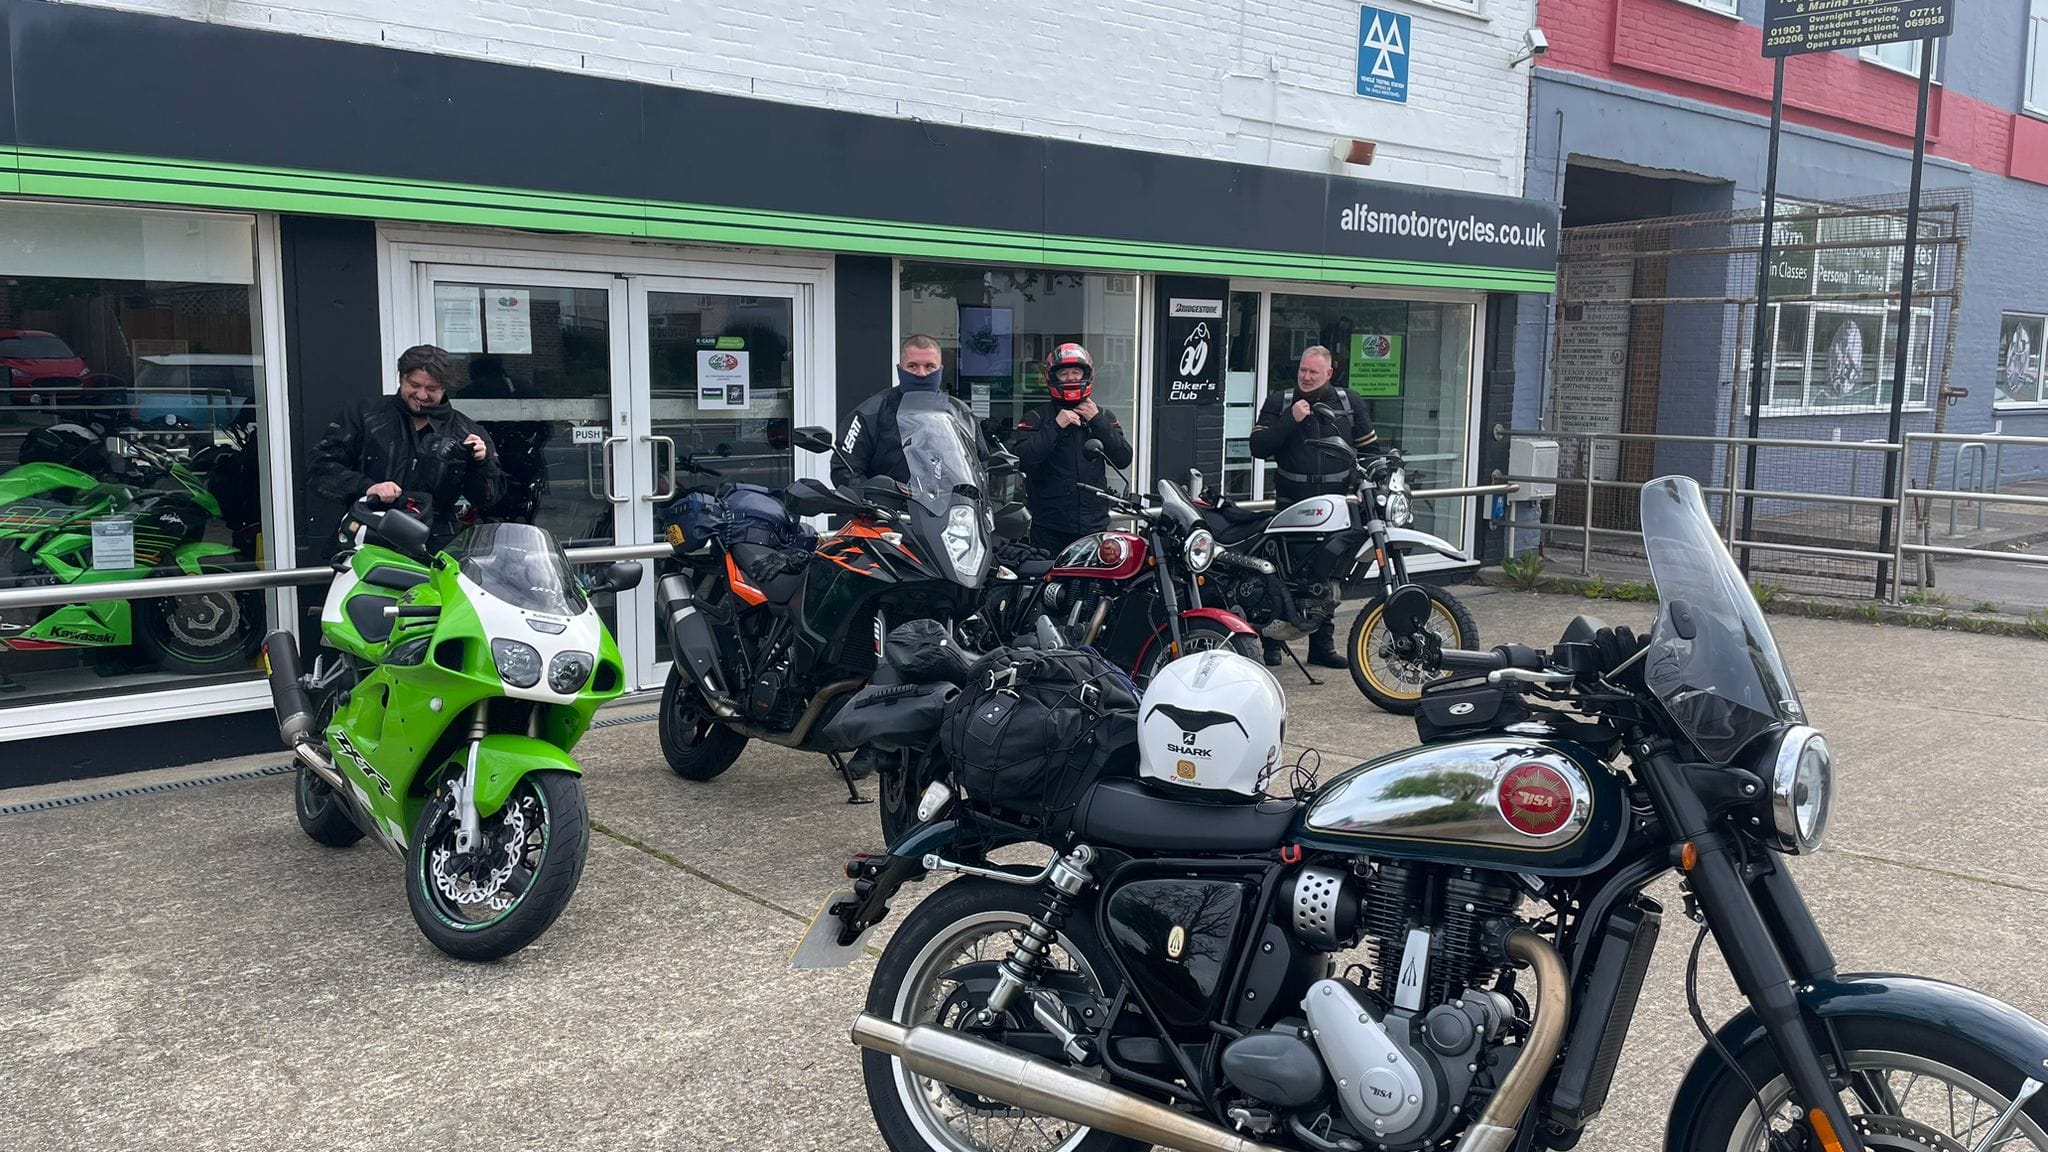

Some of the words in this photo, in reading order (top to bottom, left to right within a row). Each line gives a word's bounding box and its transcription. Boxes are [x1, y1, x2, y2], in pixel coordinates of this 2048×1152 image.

[1796, 4, 1805, 13] &
[1808, 0, 1848, 11] Marine
[1909, 6, 1942, 17] 07711
[1809, 12, 1853, 23] Overnight
[1855, 6, 1901, 17] Servicing,
[1809, 20, 1860, 31] Breakdown
[1862, 15, 1899, 25] Service,
[1904, 16, 1945, 28] 069958
[1771, 25, 1802, 36] 01903
[1808, 29, 1841, 40] Vehicle
[1843, 23, 1900, 37] Inspections,
[1767, 34, 1804, 46] 230206
[1806, 40, 1829, 50] Open
[1840, 37, 1862, 47] Days
[1874, 31, 1899, 40] Week
[1341, 203, 1546, 247] alfsmotorcycles.co.uk
[1779, 261, 1808, 280] Classes
[1819, 265, 1852, 285] Personal
[1854, 268, 1884, 292] Training
[1175, 303, 1218, 313] BRIDGESTONE
[1172, 379, 1216, 390] Biker's
[1170, 391, 1197, 400] Club
[575, 430, 600, 439] PUSH
[842, 415, 862, 454] LEATT
[50, 626, 117, 643] Kawasaki
[1167, 743, 1213, 757] SHARK
[1518, 791, 1553, 808] BSA
[1368, 1085, 1392, 1099] BSA
